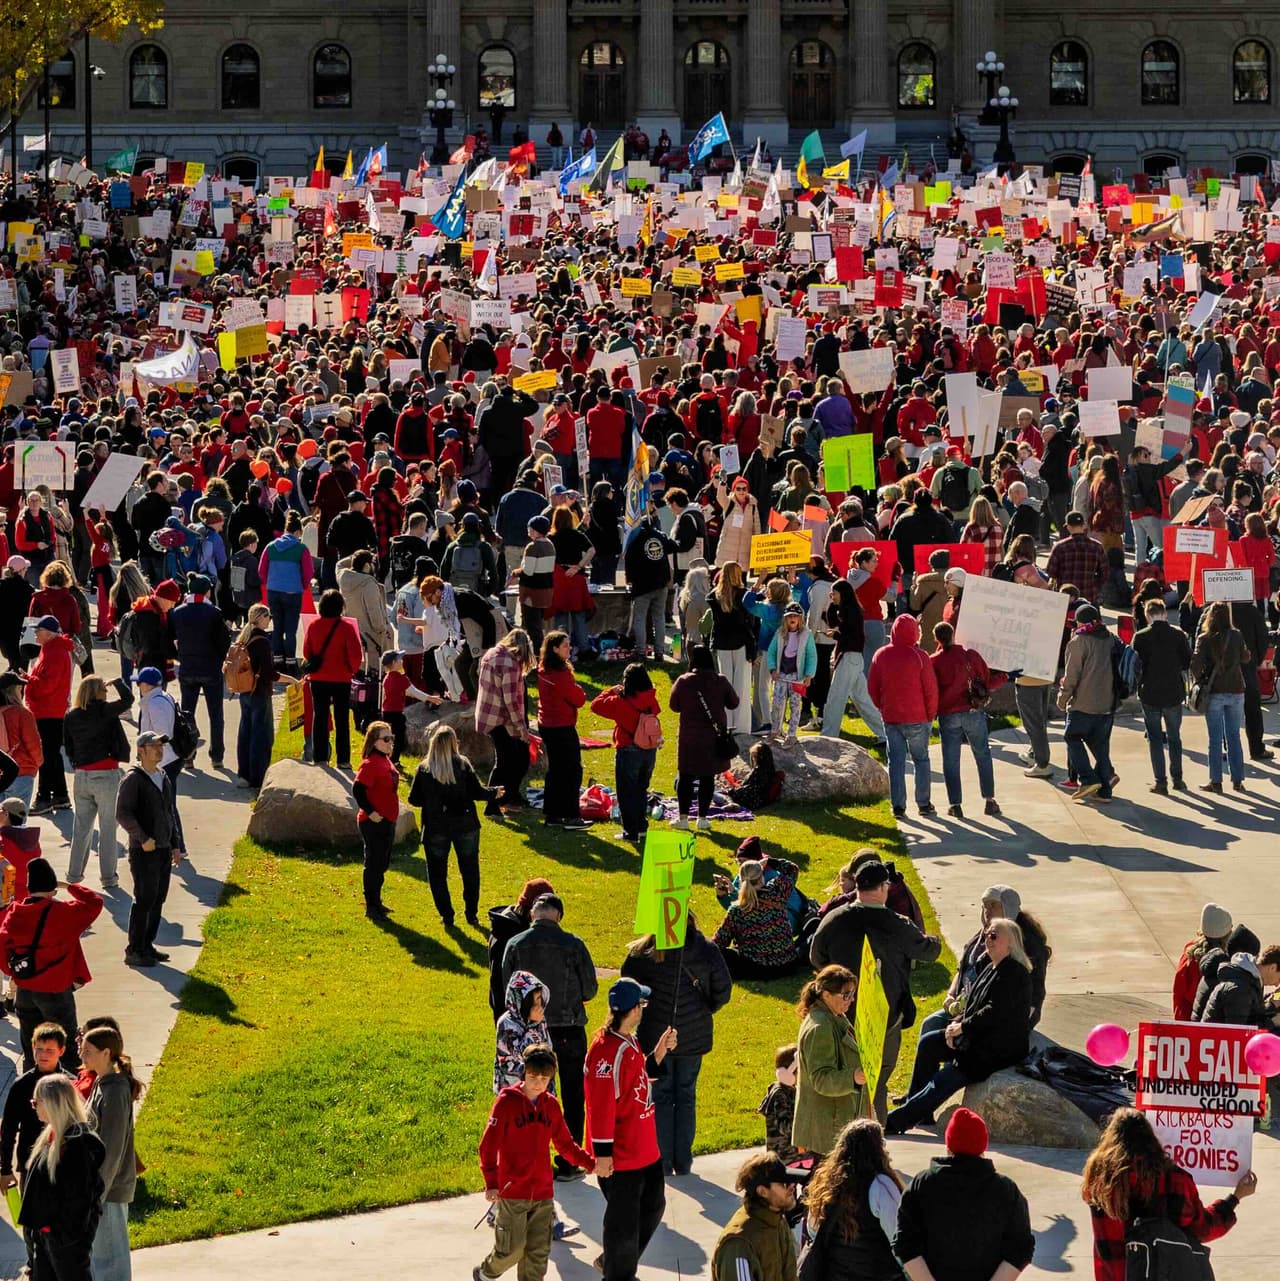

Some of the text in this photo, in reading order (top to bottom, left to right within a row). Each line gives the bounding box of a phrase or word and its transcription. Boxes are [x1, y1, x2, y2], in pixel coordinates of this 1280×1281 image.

[663, 896, 682, 947] R
[1142, 1035, 1260, 1085] FOR SAL
[1136, 1076, 1239, 1098] UNDERFUNDED
[1199, 1097, 1265, 1116] SCHOOLS
[1155, 1109, 1234, 1129] KICKBACKS
[1180, 1129, 1213, 1145] FOR
